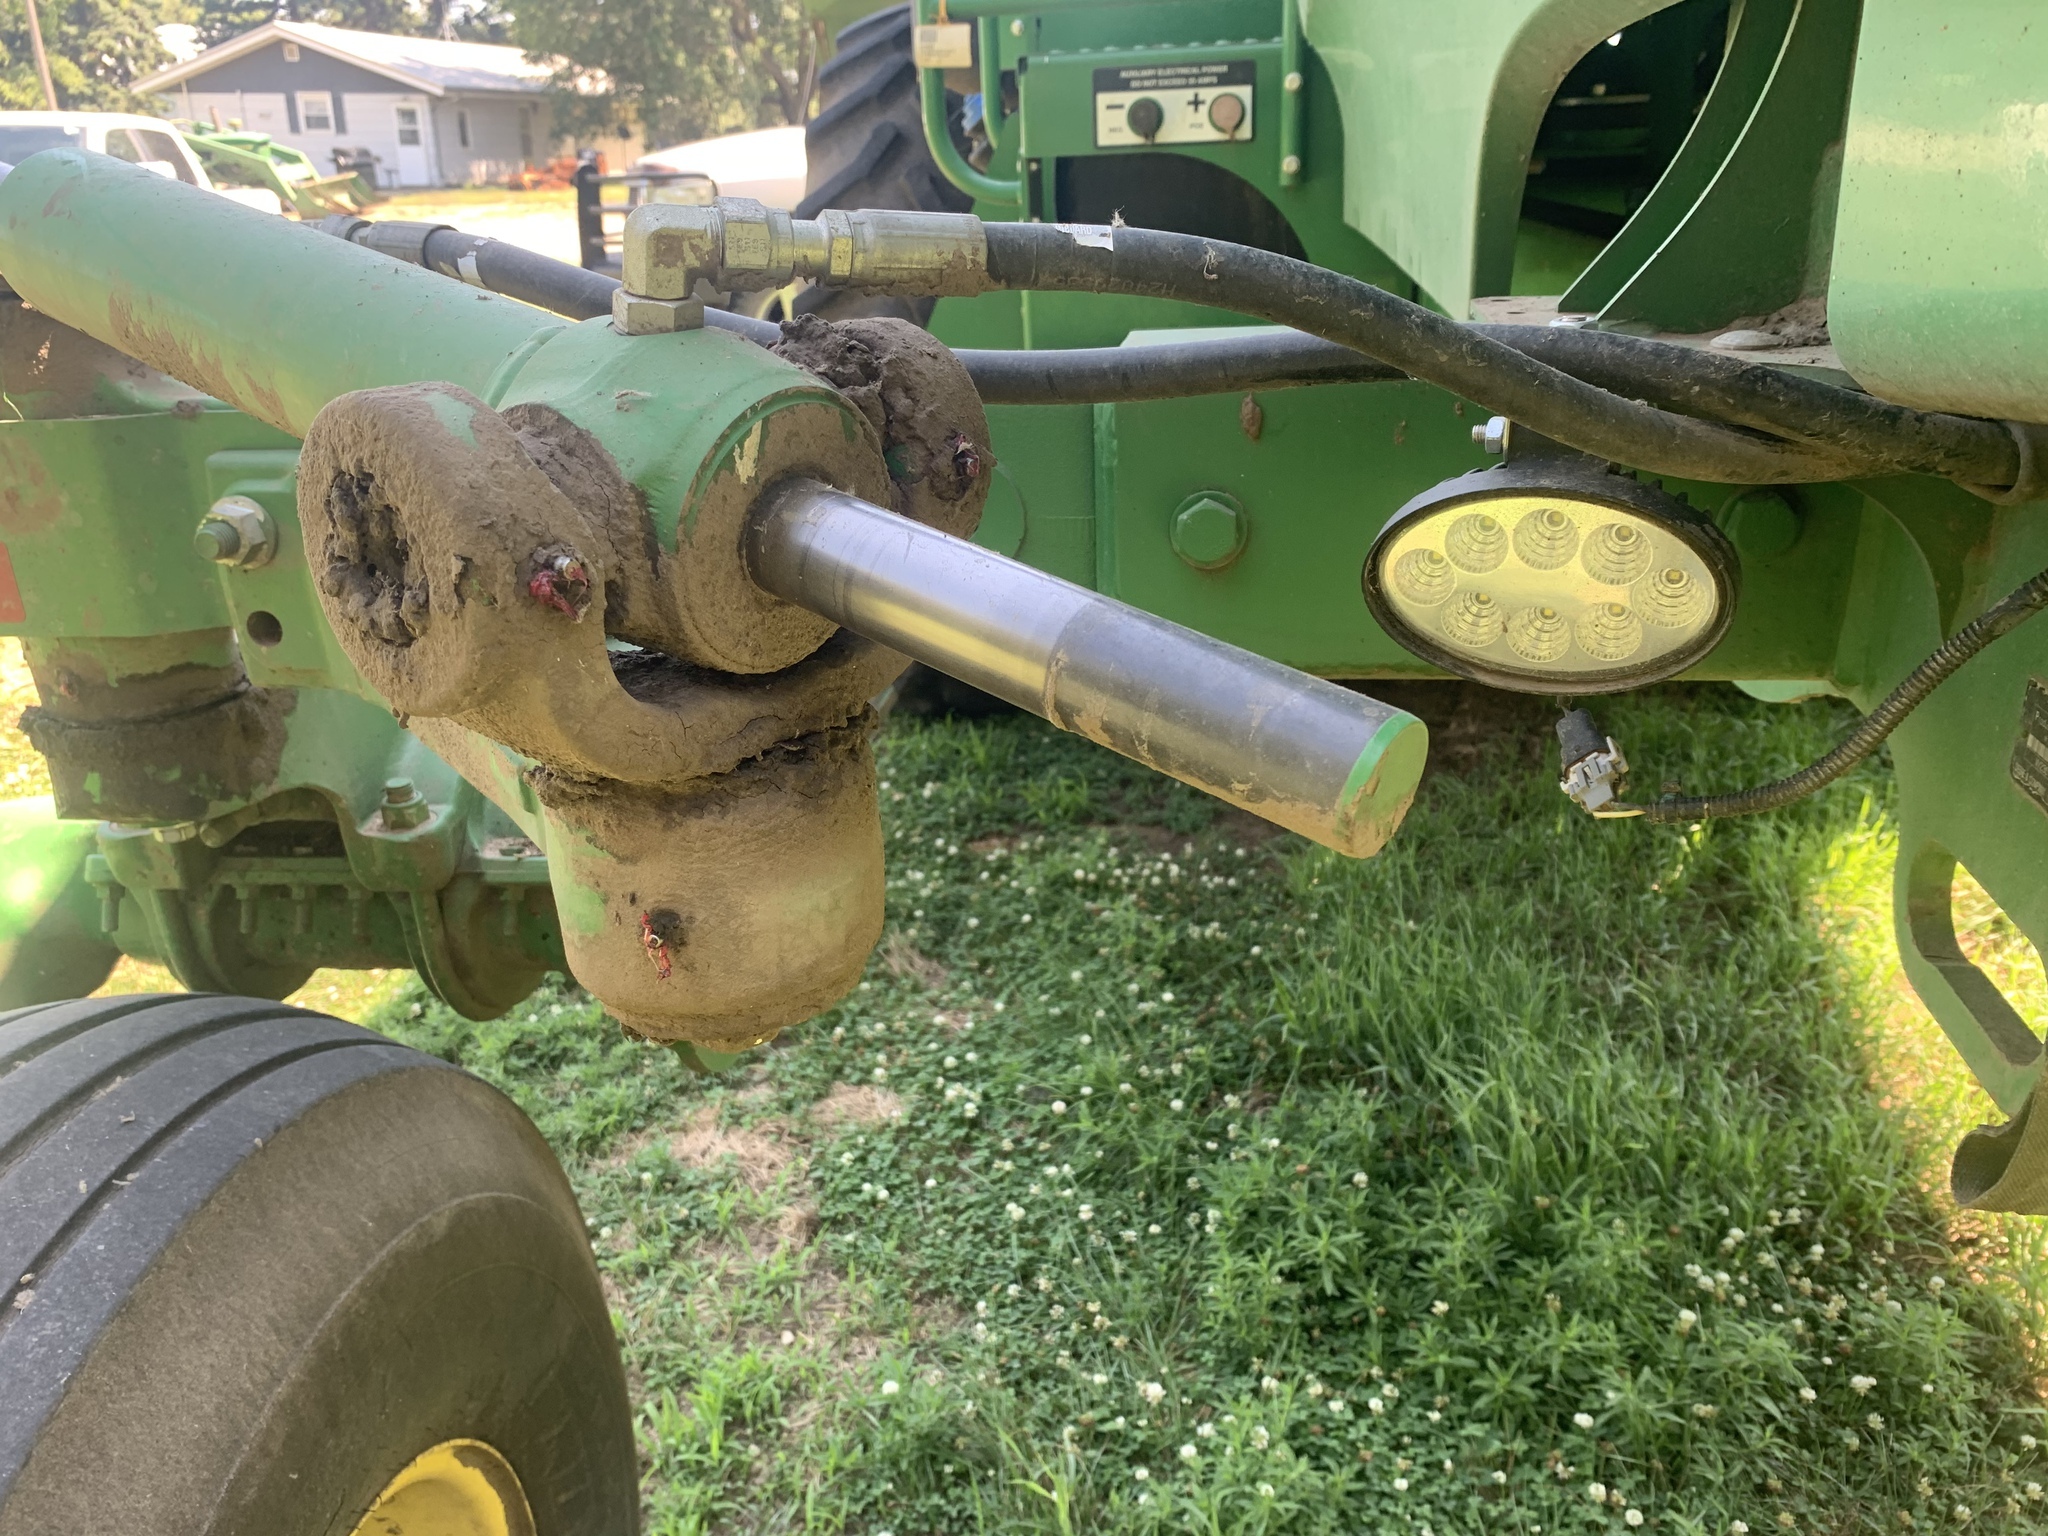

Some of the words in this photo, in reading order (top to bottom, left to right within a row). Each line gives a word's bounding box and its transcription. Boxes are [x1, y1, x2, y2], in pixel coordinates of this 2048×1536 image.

[1120, 69, 1156, 78] AUXILIARY
[1157, 66, 1200, 76] ELECTRICAL
[1201, 65, 1228, 74] POWER
[1130, 80, 1142, 88] DO
[1143, 79, 1156, 87] NOT
[1158, 77, 1187, 86] EXCEED
[1198, 76, 1218, 84] AMPS
